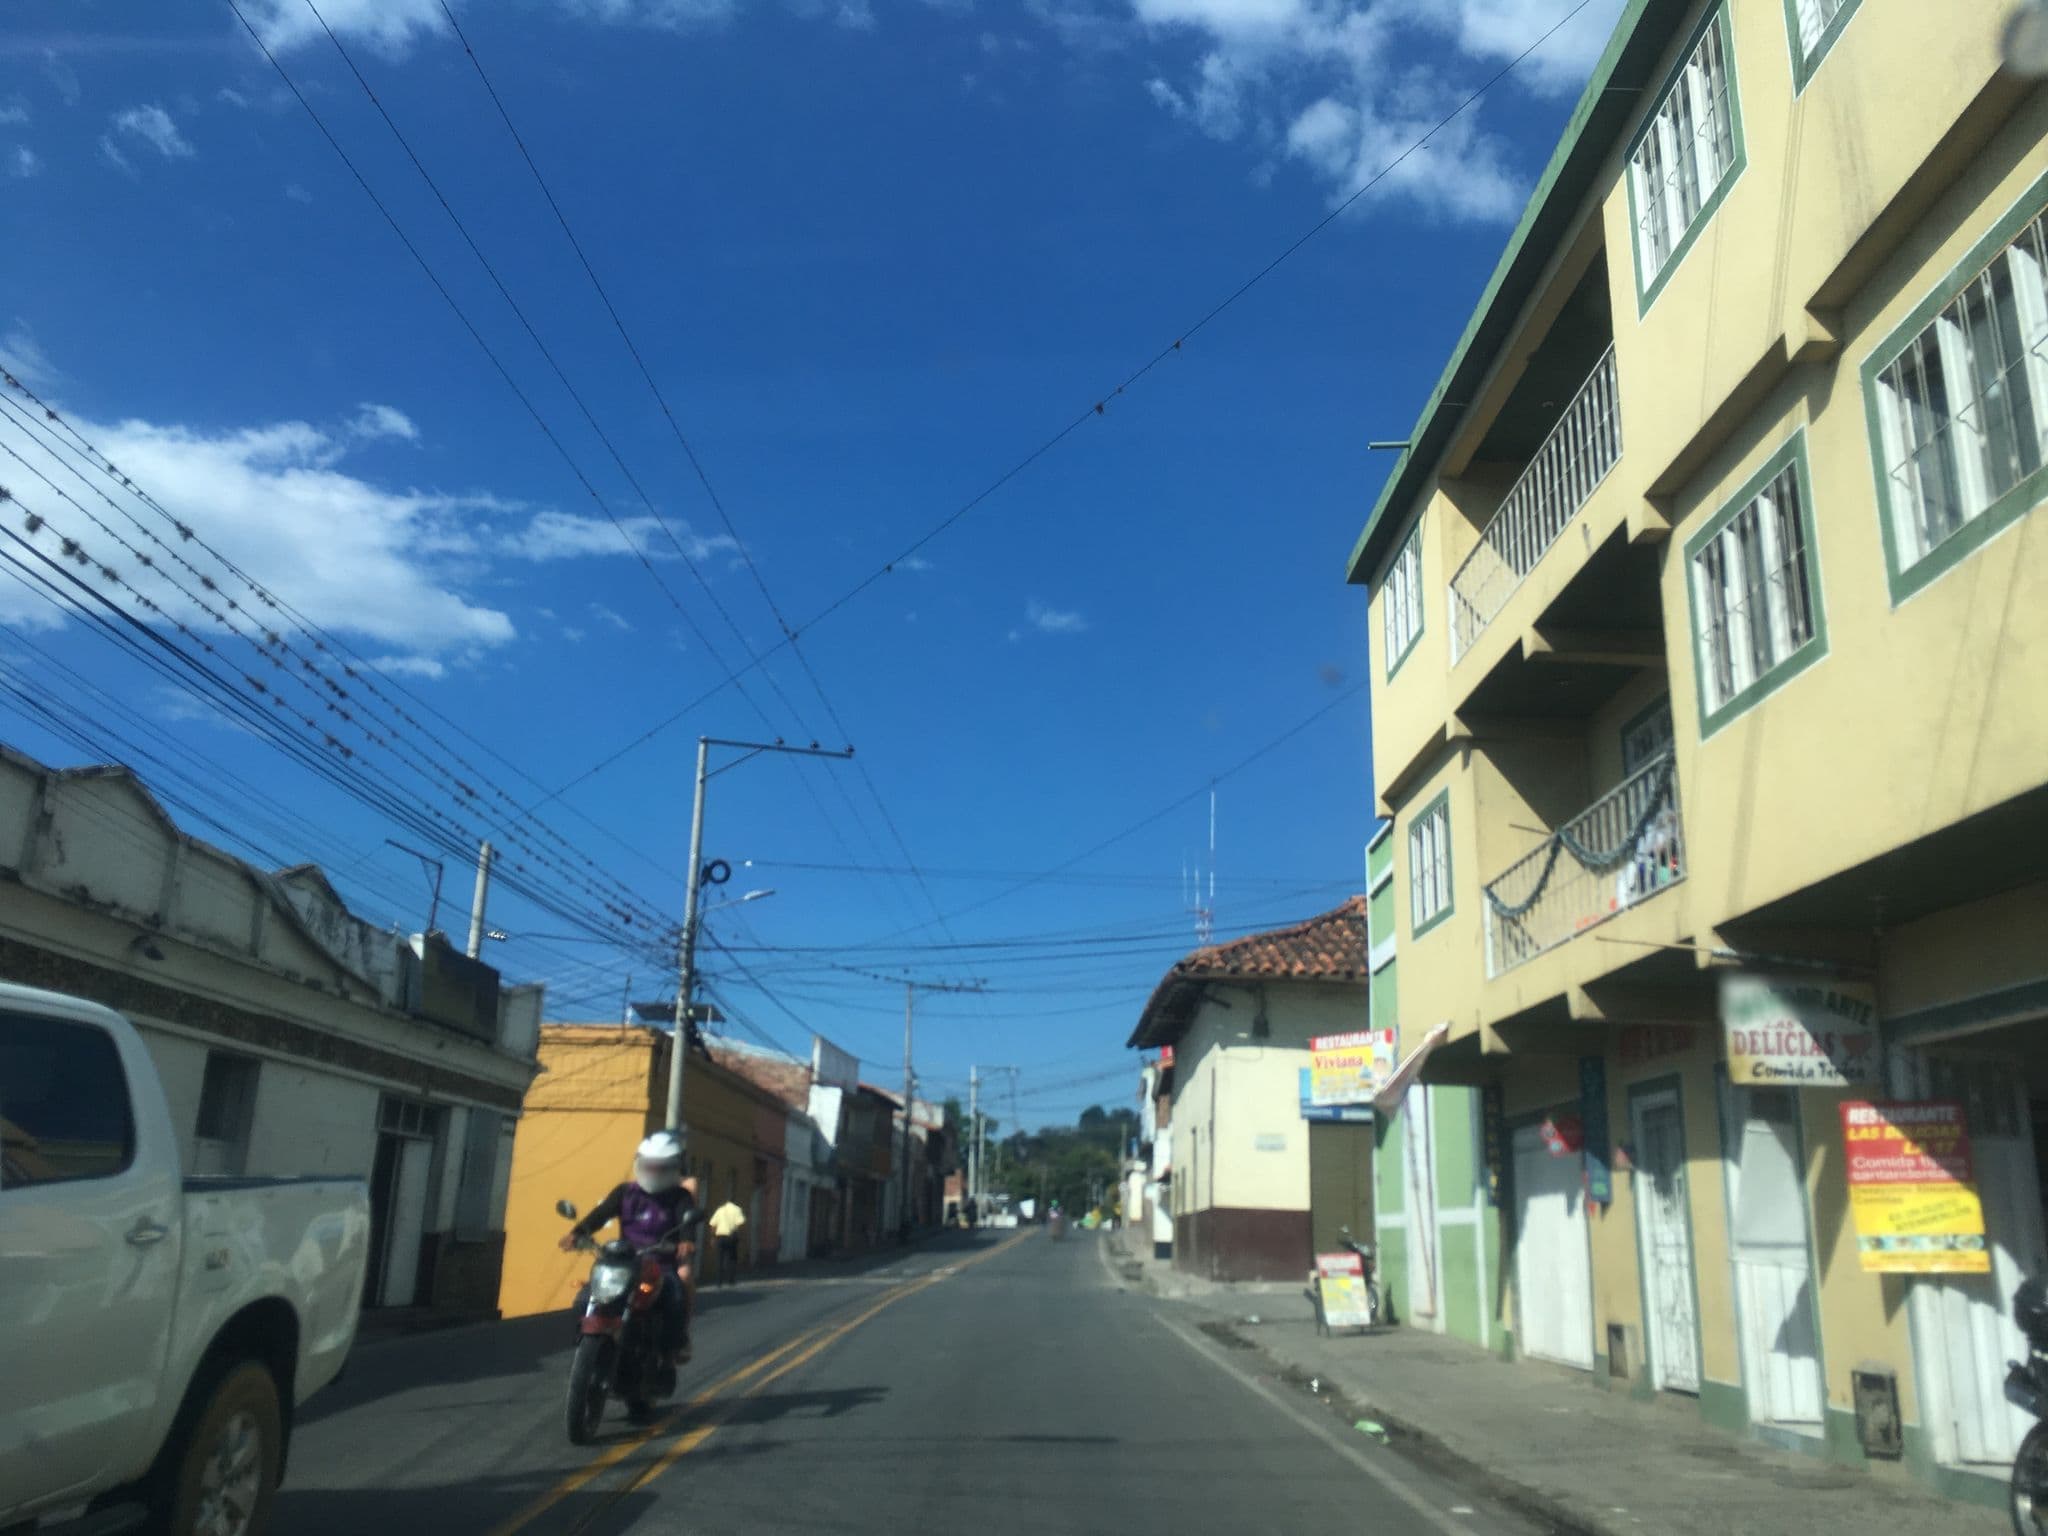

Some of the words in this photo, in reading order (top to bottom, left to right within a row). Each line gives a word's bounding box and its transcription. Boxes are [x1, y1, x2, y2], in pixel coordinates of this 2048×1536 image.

[1732, 1030, 1834, 1057] DELICIAS
[1752, 1061, 1814, 1079] Comida
[1848, 1105, 1956, 1125] RESTAURANTE
[1847, 1126, 1880, 1142] LAS
[1852, 1155, 1916, 1169] Comida
